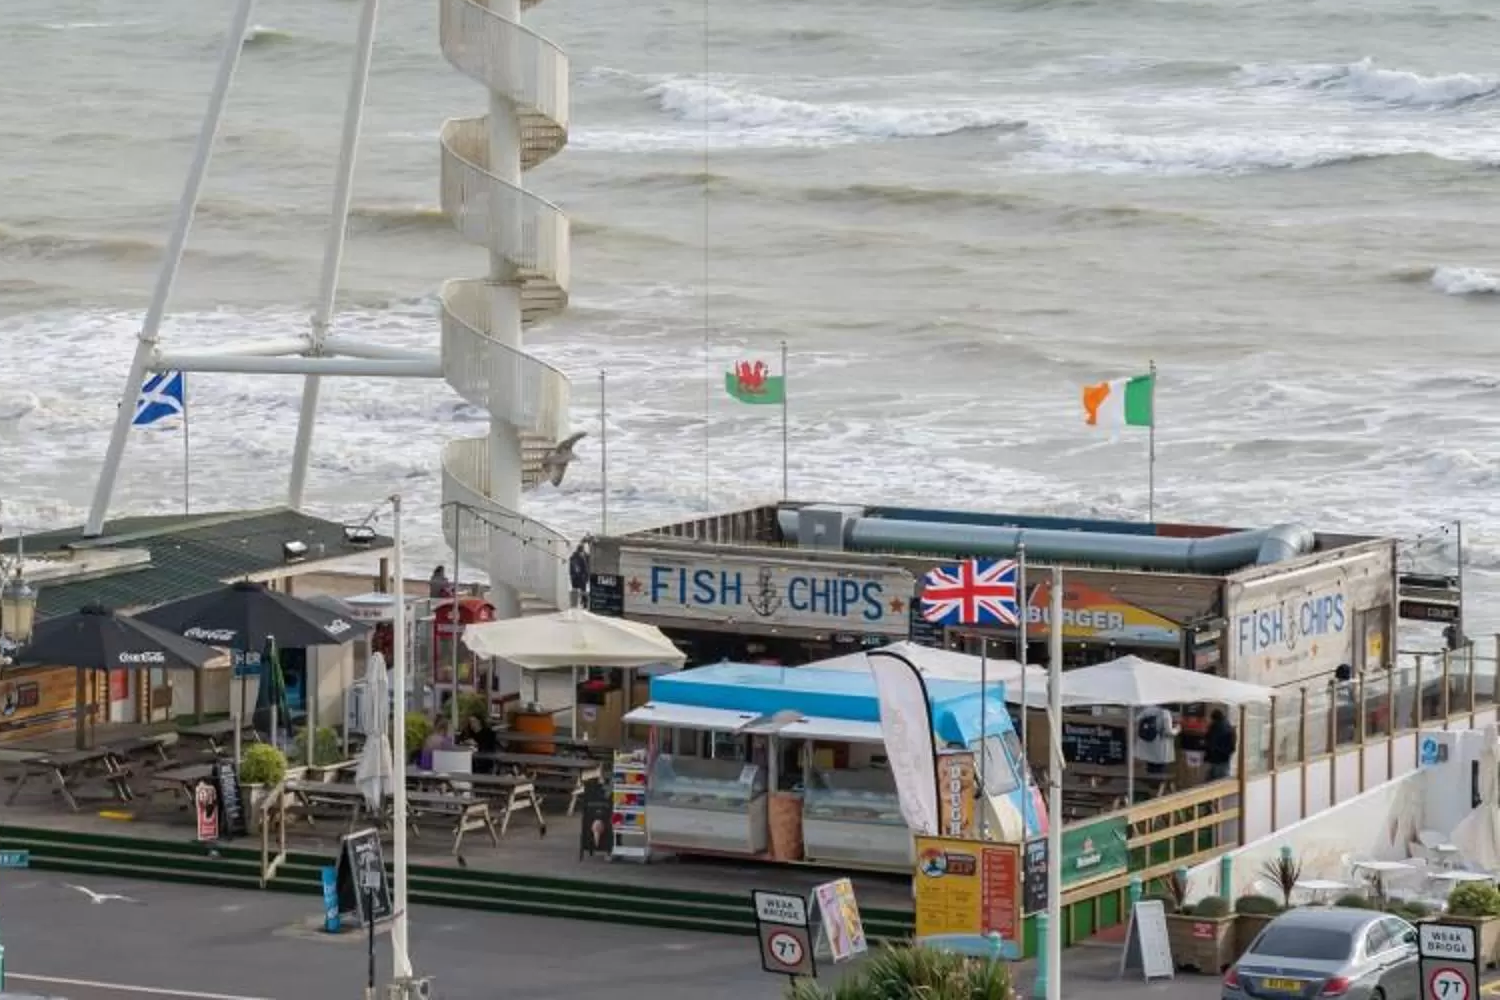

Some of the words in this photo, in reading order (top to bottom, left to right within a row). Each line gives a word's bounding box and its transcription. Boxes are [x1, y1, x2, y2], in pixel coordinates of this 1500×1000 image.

[651, 565, 742, 605] FISH
[787, 576, 884, 621] CHIPS
[1027, 606, 1125, 631] BURGER
[1239, 609, 1284, 656] FISH
[1299, 593, 1345, 636] CHIPS
[1427, 941, 1467, 953] BRIDGE
[1431, 931, 1461, 941] WEAK
